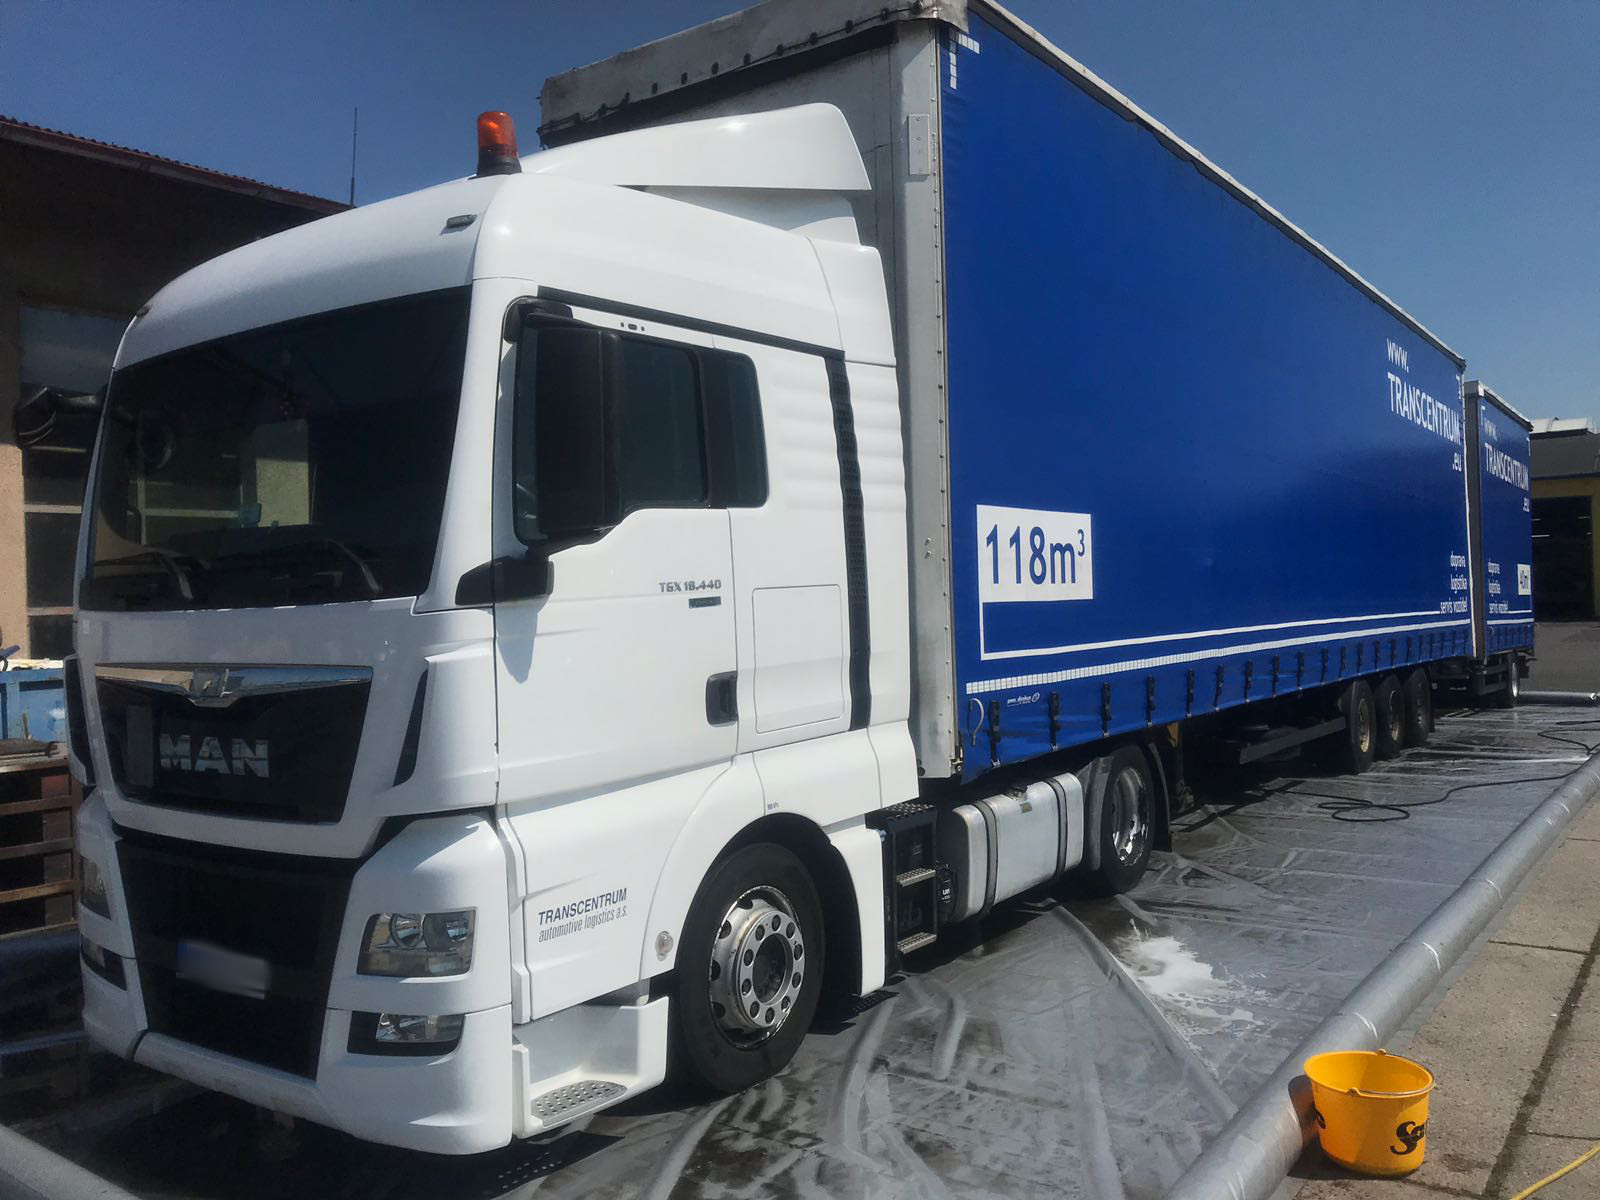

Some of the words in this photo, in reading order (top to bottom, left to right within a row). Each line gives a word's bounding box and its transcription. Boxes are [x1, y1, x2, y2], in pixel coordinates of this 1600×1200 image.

[1386, 337, 1410, 373] www.
[1387, 371, 1461, 446] TRANSCENTRUM
[1484, 442, 1530, 491] TRANSCENTRUM
[659, 581, 682, 593] TGX
[684, 579, 721, 591] 18.440
[159, 733, 269, 778] MAN
[538, 887, 627, 926] TRANSCENTRUM
[538, 918, 583, 943] automotive
[584, 905, 615, 930] logistics
[615, 904, 628, 920] a.s.
